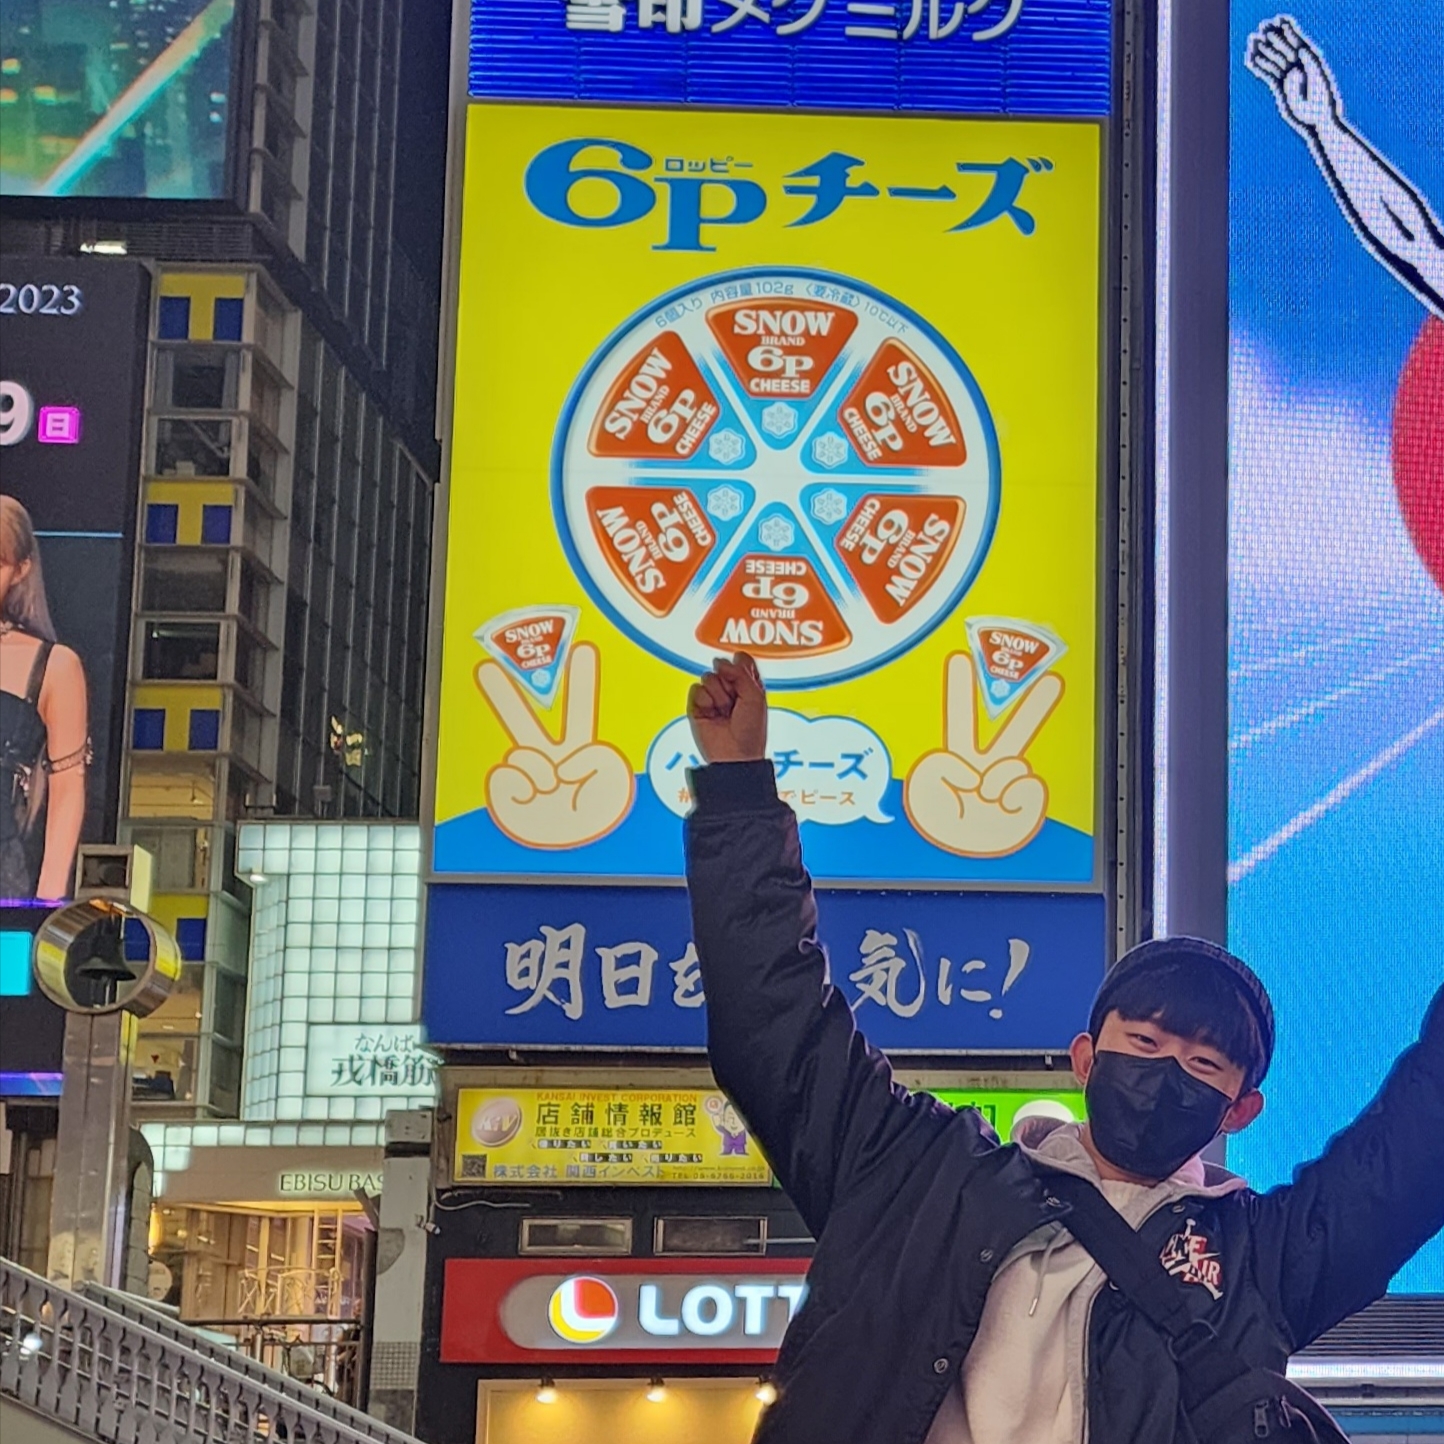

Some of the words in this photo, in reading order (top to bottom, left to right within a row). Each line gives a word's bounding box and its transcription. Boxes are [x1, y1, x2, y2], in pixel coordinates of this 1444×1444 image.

[665, 155, 753, 173] ロッピー
[0, 283, 83, 315] 2023
[733, 309, 835, 336] SNOW
[761, 336, 805, 346] BRAND
[604, 347, 673, 441] SNOW
[750, 377, 811, 393] CHEESE
[639, 384, 670, 425] BRAND
[886, 360, 957, 448] SNOW
[889, 393, 918, 433] BRAND
[675, 401, 717, 455] CHEESE
[843, 407, 883, 461] CHEESE
[673, 490, 712, 547] CHEESE
[839, 498, 881, 552] CHEESE
[596, 506, 667, 594] SNOW
[885, 513, 950, 607] SNOW
[745, 560, 807, 576] CHEESE
[750, 608, 795, 619] BRAND
[504, 619, 554, 643] SNOW
[719, 617, 823, 647] SNOW
[989, 631, 1039, 655] SNOW
[504, 923, 1030, 1021] 明日を気に!
[536, 1092, 576, 1101] KANSAI
[579, 1093, 616, 1102] INVEST
[621, 1093, 697, 1102] CORPORATION
[536, 1102, 697, 1126] 店舗情報館
[280, 1173, 343, 1191] EBISU
